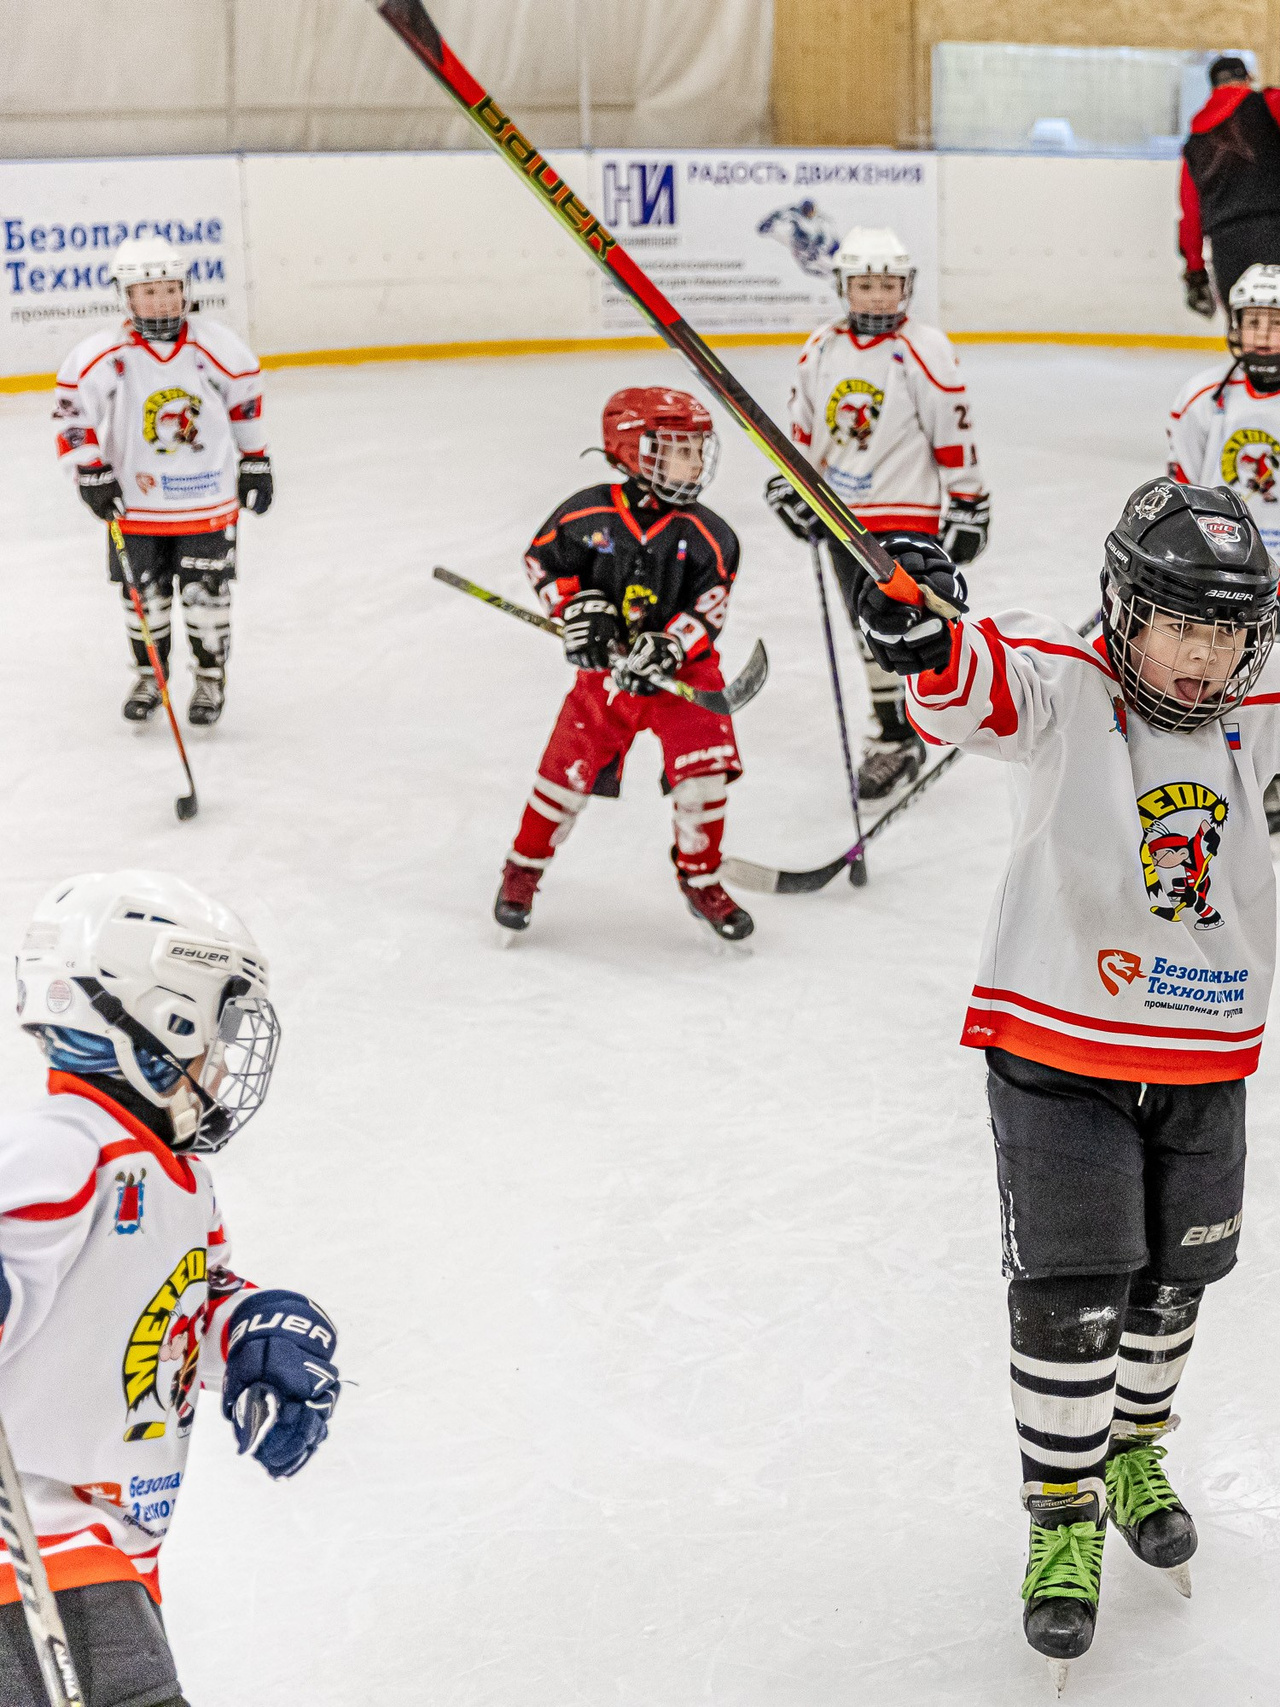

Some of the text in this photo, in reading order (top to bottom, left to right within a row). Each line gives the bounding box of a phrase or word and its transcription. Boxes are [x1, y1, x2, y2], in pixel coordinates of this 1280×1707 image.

[687, 162, 925, 186] РАДОСТЬ ДВИЖЕНИЯ
[6, 260, 224, 293] Техноии
[1106, 540, 1129, 564] BAUER
[1205, 589, 1254, 601] BAUER
[171, 946, 230, 963] BAUER
[1144, 1000, 1220, 1017] промышленная
[1181, 1208, 1242, 1246] BAU
[124, 1249, 207, 1408] МЕТЕО
[228, 1311, 333, 1349] AUER
[129, 1471, 182, 1498] Безопа
